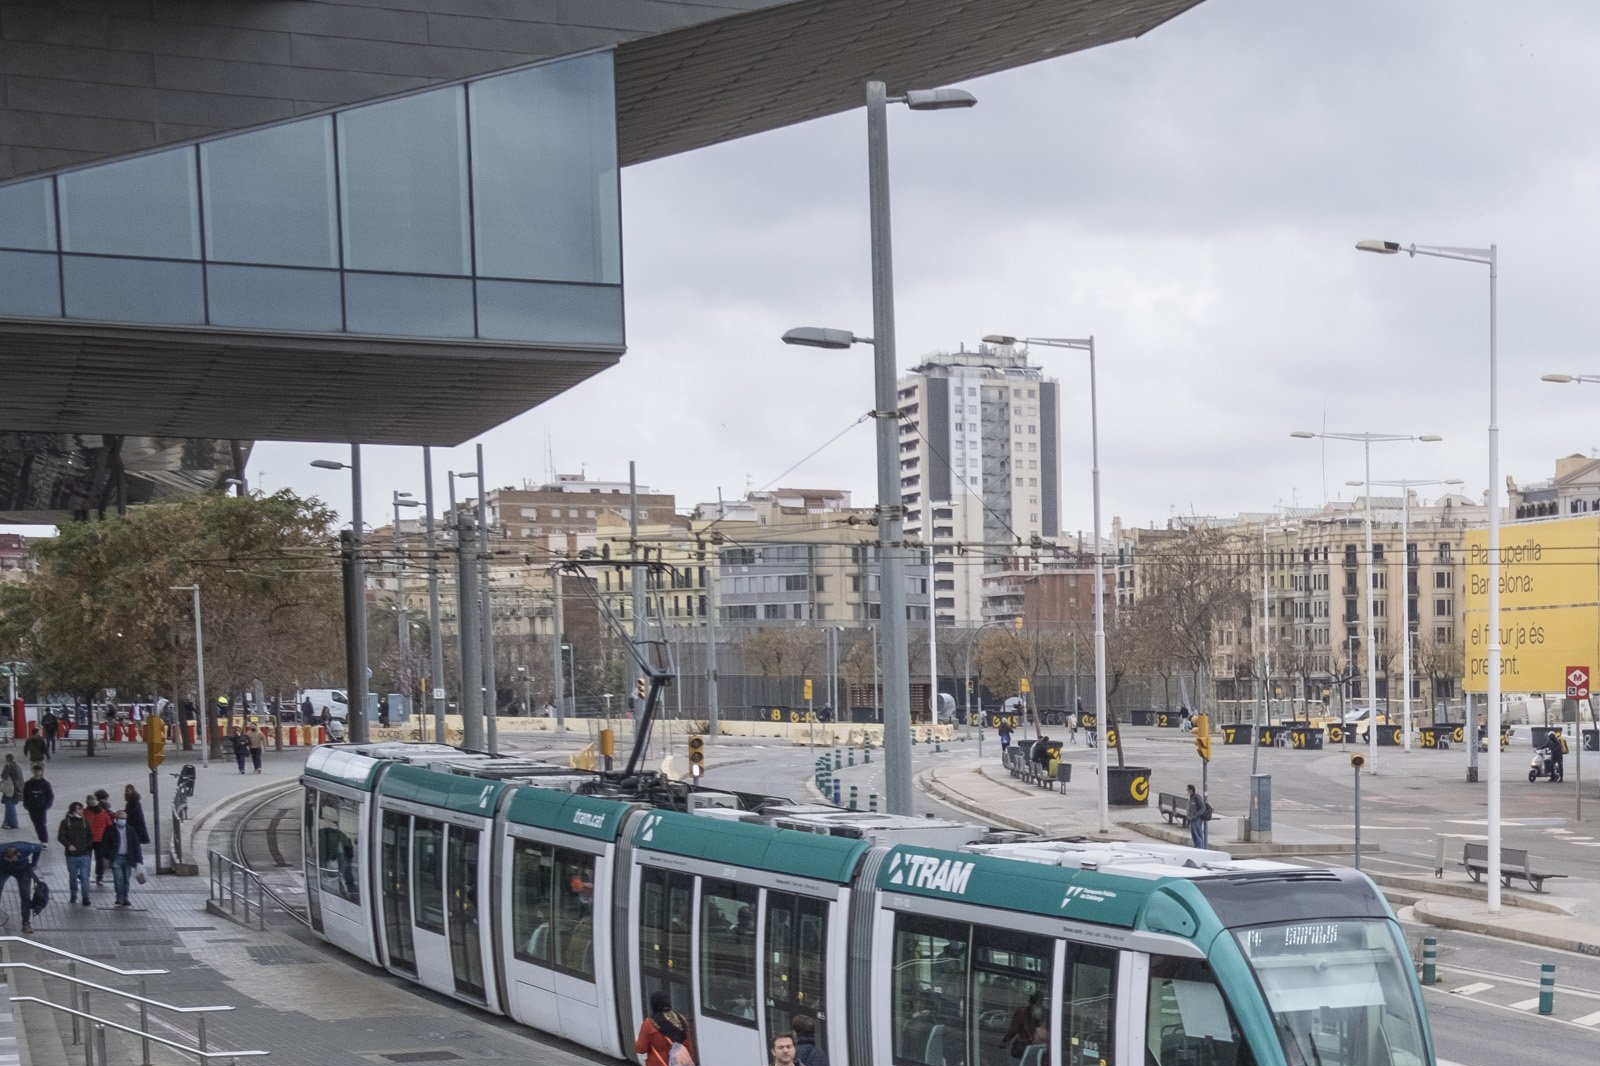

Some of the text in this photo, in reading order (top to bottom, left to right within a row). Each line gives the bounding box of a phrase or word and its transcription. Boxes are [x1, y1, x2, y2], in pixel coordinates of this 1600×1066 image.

[1498, 538, 1542, 569] uperilla
[1471, 571, 1533, 595] Barelona:
[1471, 622, 1545, 650] el fur ja és
[1471, 655, 1520, 681] preent.
[1573, 673, 1583, 682] M
[908, 855, 976, 895] TRAM
